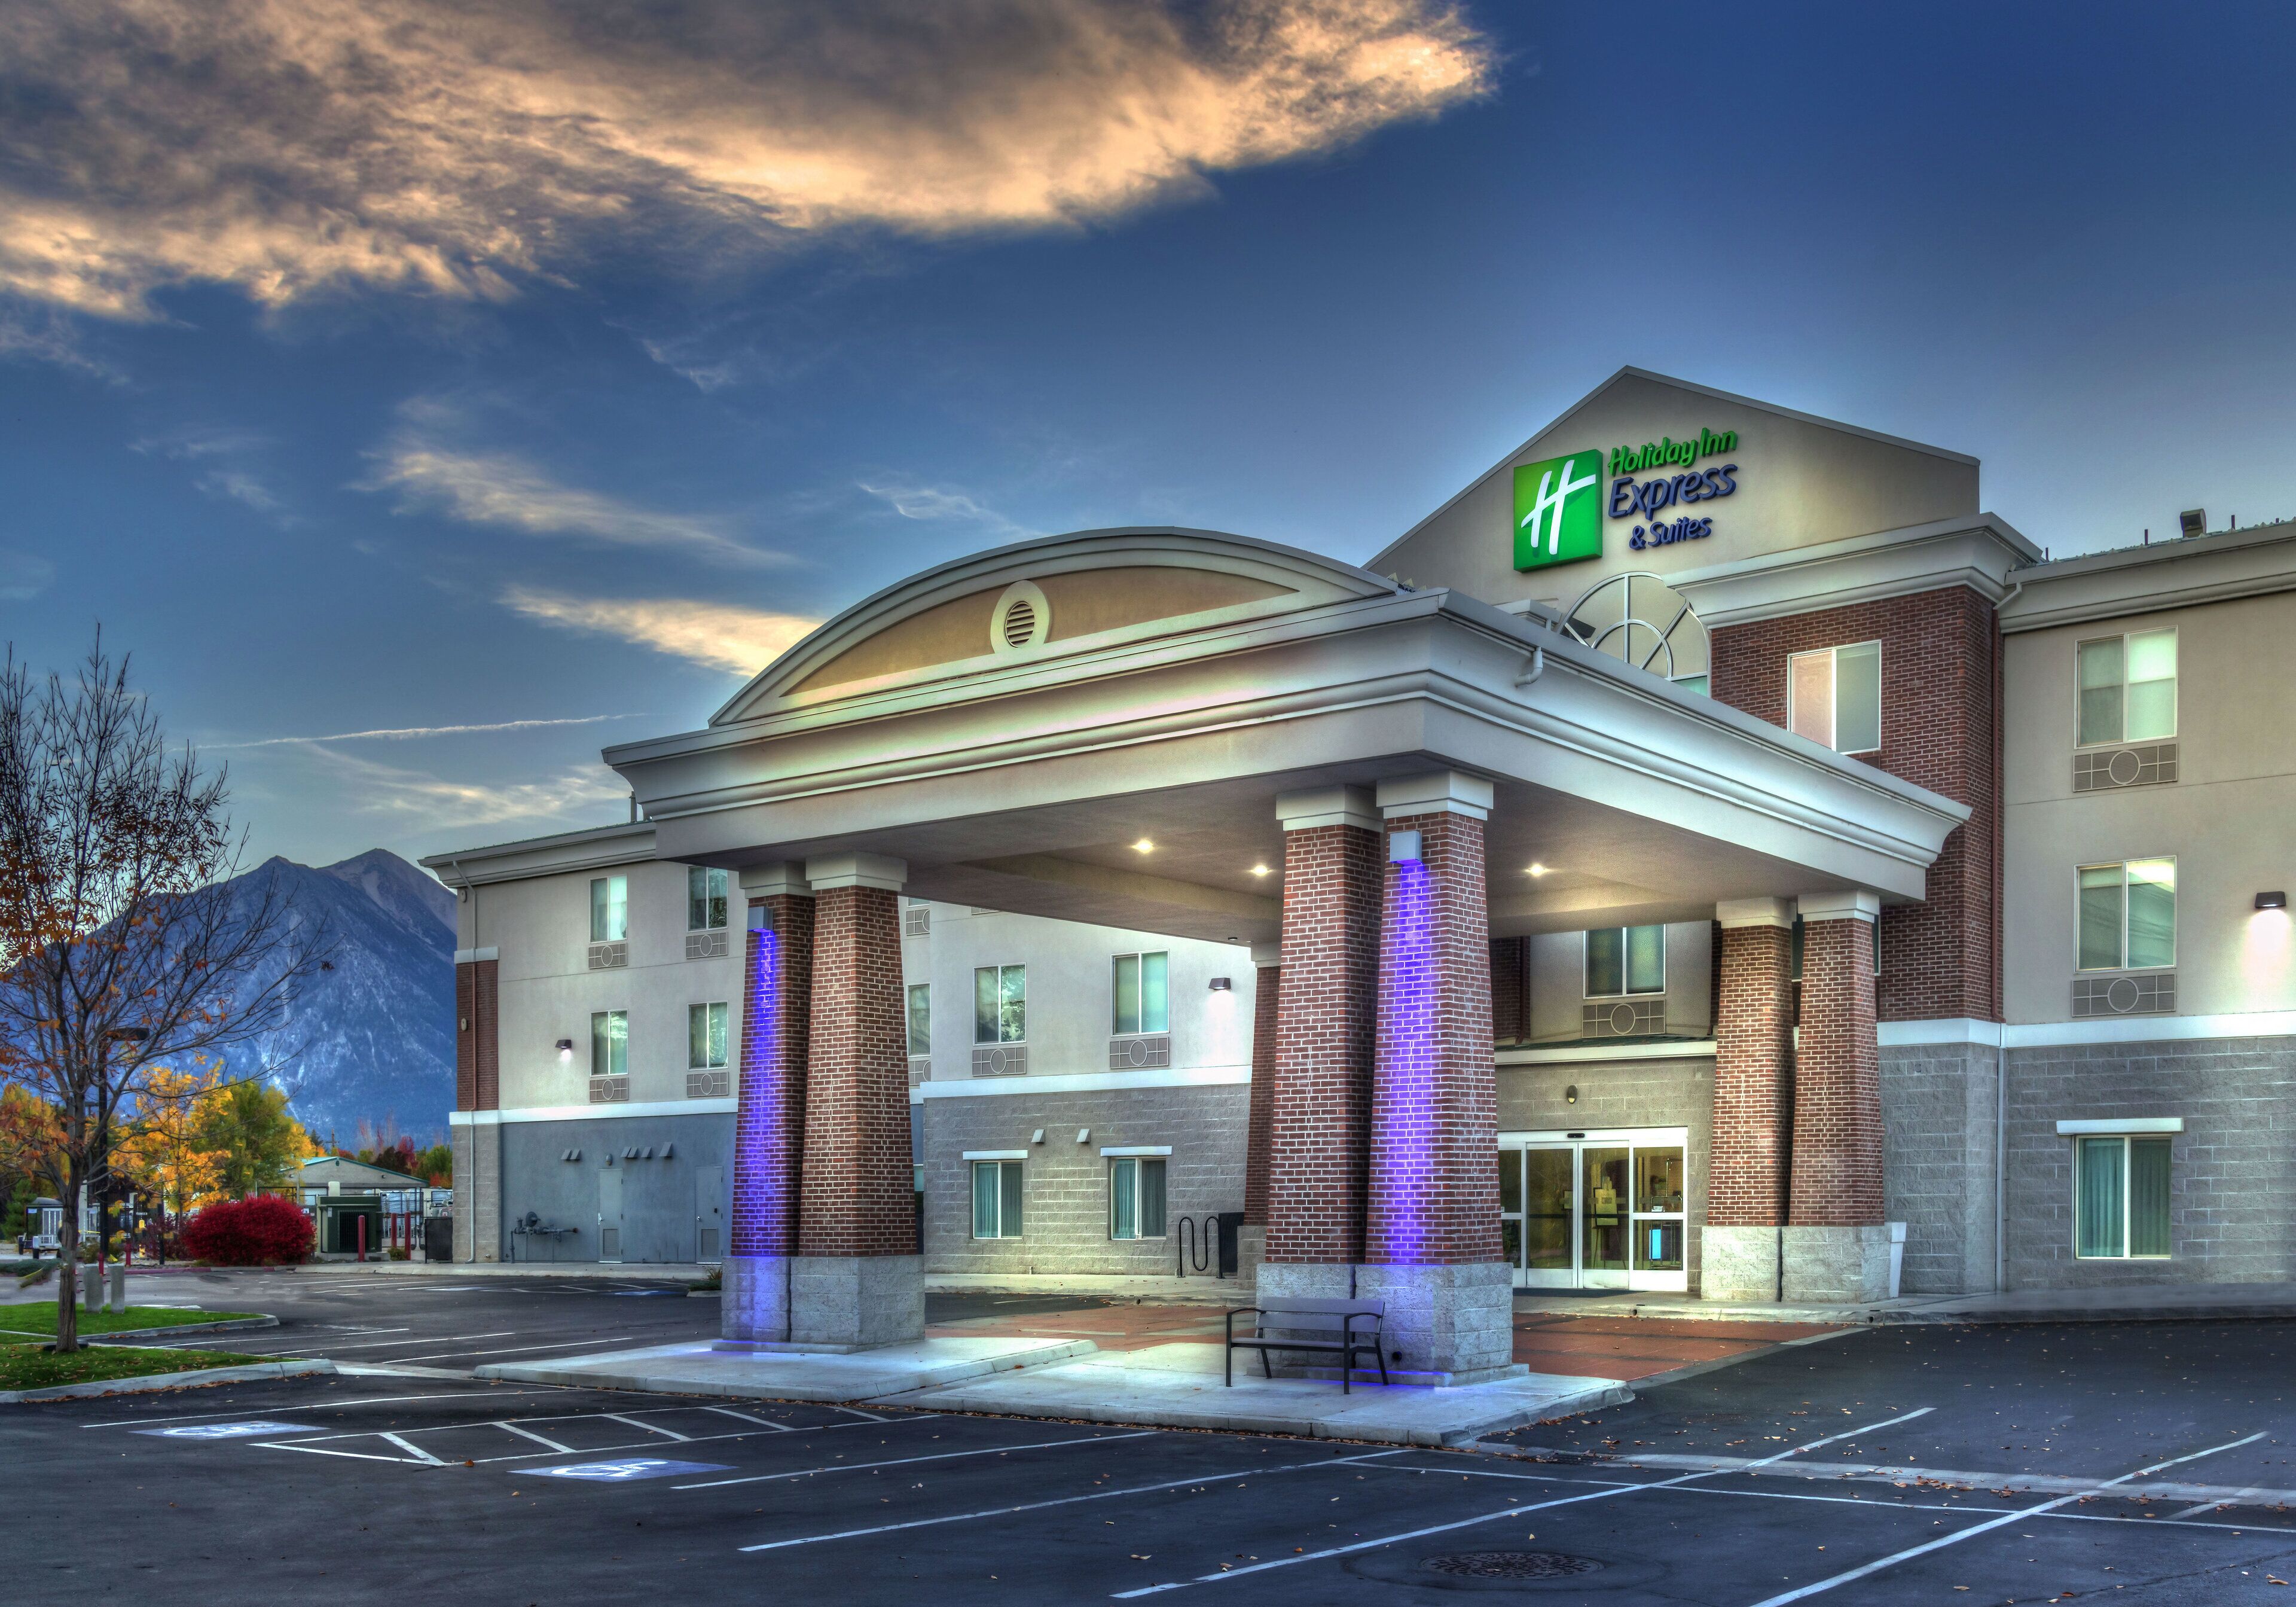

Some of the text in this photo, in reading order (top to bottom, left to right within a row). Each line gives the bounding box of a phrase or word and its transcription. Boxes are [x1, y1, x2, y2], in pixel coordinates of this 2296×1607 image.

[1608, 427, 1738, 477] Holiday Inn
[1608, 464, 1738, 522] Express
[1629, 516, 1713, 551] & Suites
